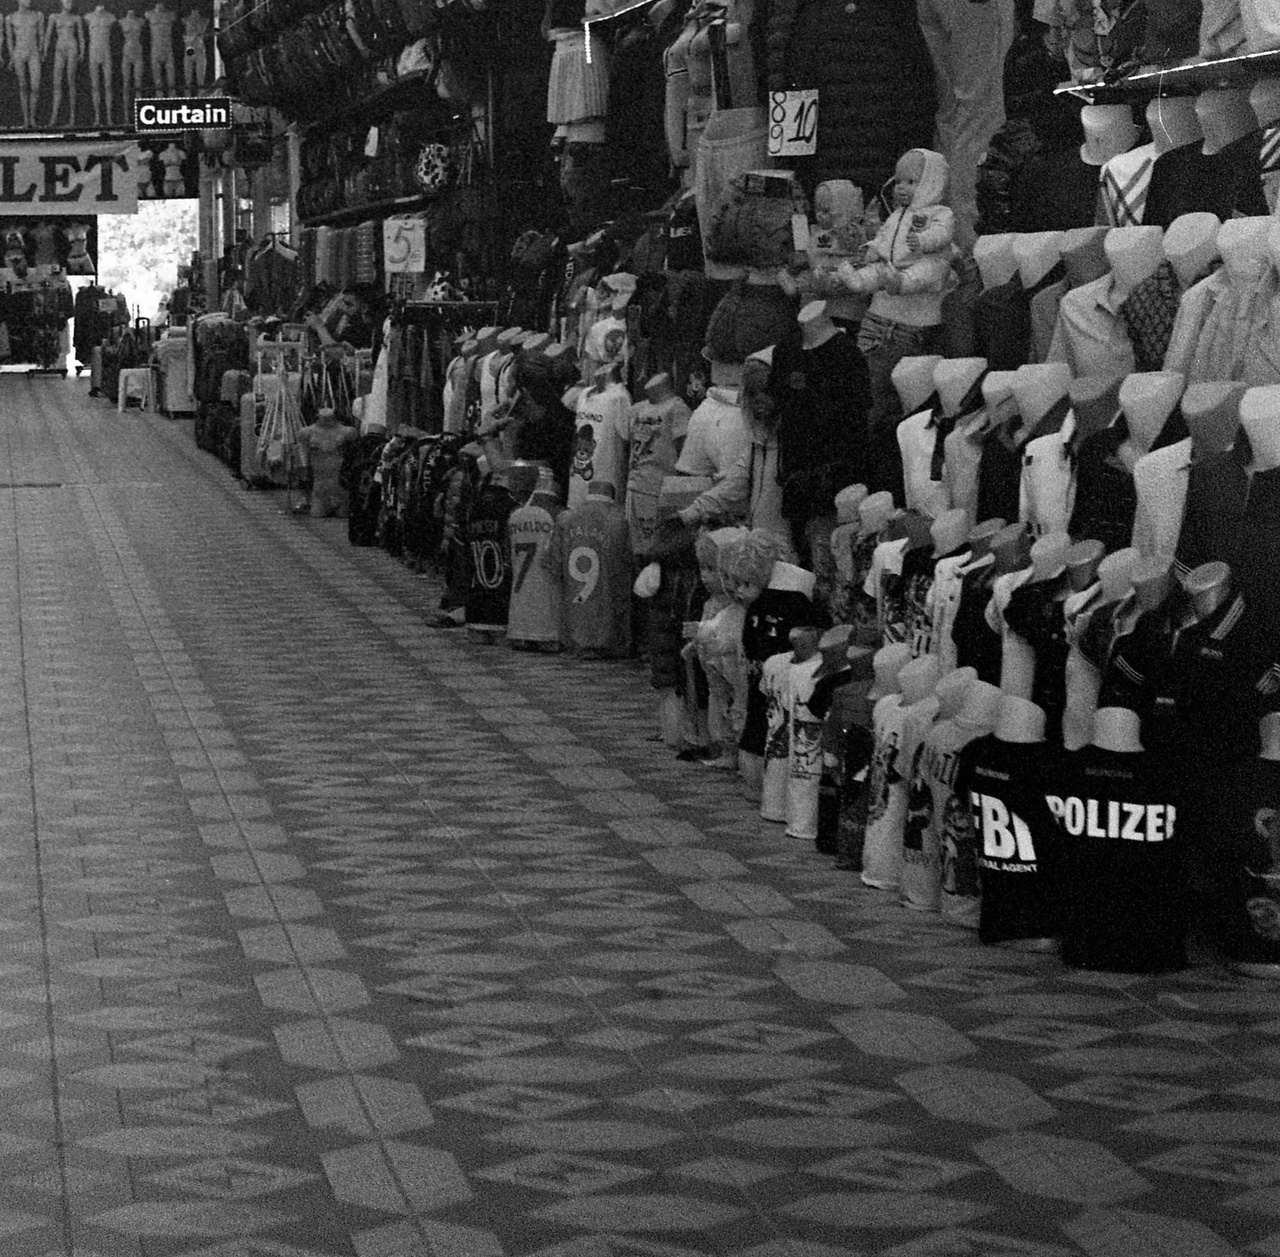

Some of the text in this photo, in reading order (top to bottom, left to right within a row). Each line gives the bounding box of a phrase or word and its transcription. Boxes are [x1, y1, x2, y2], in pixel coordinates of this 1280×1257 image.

[140, 104, 226, 125] Curtain
[788, 100, 818, 144] 10
[388, 226, 415, 264] 5
[515, 542, 537, 594] 7
[568, 545, 600, 604] 9
[1002, 862, 1037, 873] AGENT
